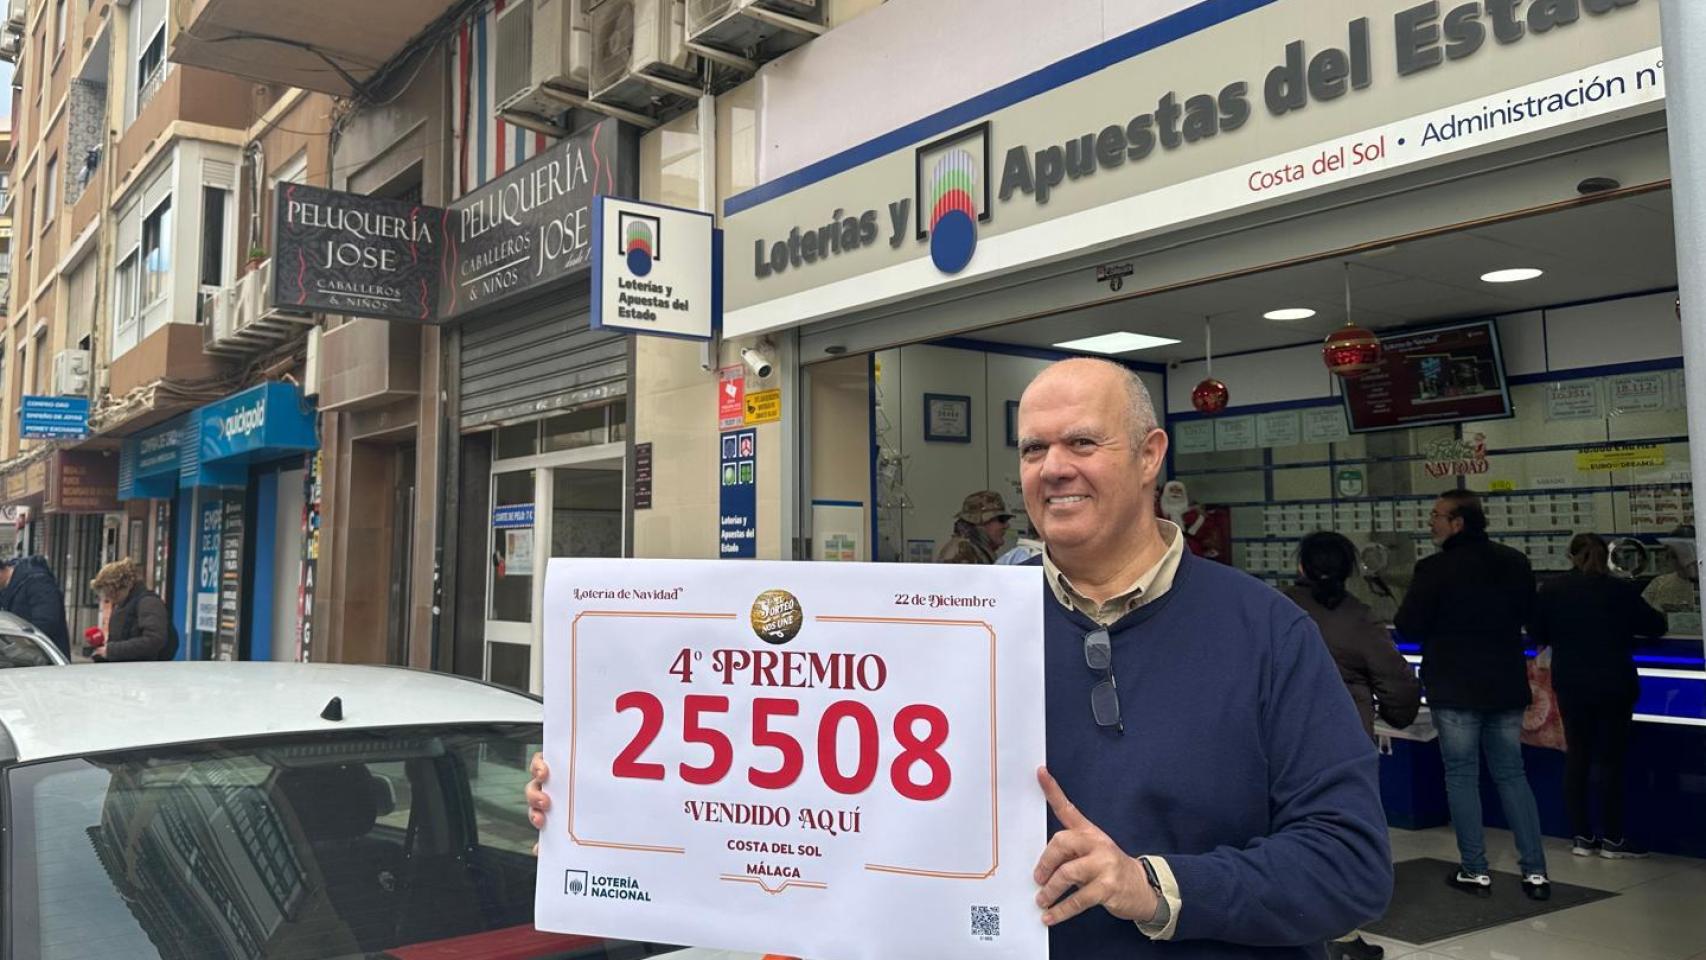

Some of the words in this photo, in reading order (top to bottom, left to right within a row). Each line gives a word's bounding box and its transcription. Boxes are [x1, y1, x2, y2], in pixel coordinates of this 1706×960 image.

[1248, 164, 1305, 193] Costa
[1312, 146, 1345, 177] del
[1353, 135, 1385, 167] Sol
[1420, 75, 1626, 147] Administración
[754, 208, 878, 279] Loterías
[888, 198, 912, 249] y
[997, 78, 1250, 204] Apuestas
[1263, 16, 1373, 116] del
[460, 143, 589, 243] PELUQUERÍA
[287, 200, 433, 244] PELUQUERÍA
[536, 206, 589, 277] JOSE
[324, 241, 396, 272] JOSE
[461, 231, 531, 277] CABALLEROS
[316, 279, 401, 297] CABALLEROS
[469, 288, 478, 301] &
[482, 268, 518, 296] NIÑOS
[618, 277, 663, 294] Loterías
[665, 286, 673, 298] y
[329, 296, 339, 305] &
[345, 297, 389, 309] NIÑOS
[618, 292, 670, 310] Apuestas
[672, 299, 689, 311] del
[618, 306, 657, 321] Estado
[225, 399, 266, 441] quickgold
[721, 529, 745, 540] Apuestas
[746, 528, 754, 538] del
[721, 543, 739, 553] Estado
[617, 588, 631, 599] de
[632, 587, 684, 600] Navidad
[894, 593, 910, 605] 22
[911, 593, 926, 606] de
[928, 593, 997, 608] Diciembre
[760, 599, 794, 618] SORTEO
[777, 615, 794, 628] UNE
[711, 648, 888, 692] PREMIO
[612, 691, 952, 801] 25508
[684, 800, 791, 828] VENDIDO
[798, 806, 863, 836] AQUÍ
[727, 840, 769, 853] COSTA
[771, 843, 795, 855] DEL
[797, 845, 823, 857] SOL
[746, 861, 801, 879] MÁLAGA
[592, 875, 640, 890] LOTERÍA
[591, 887, 652, 902] NACIONAL
